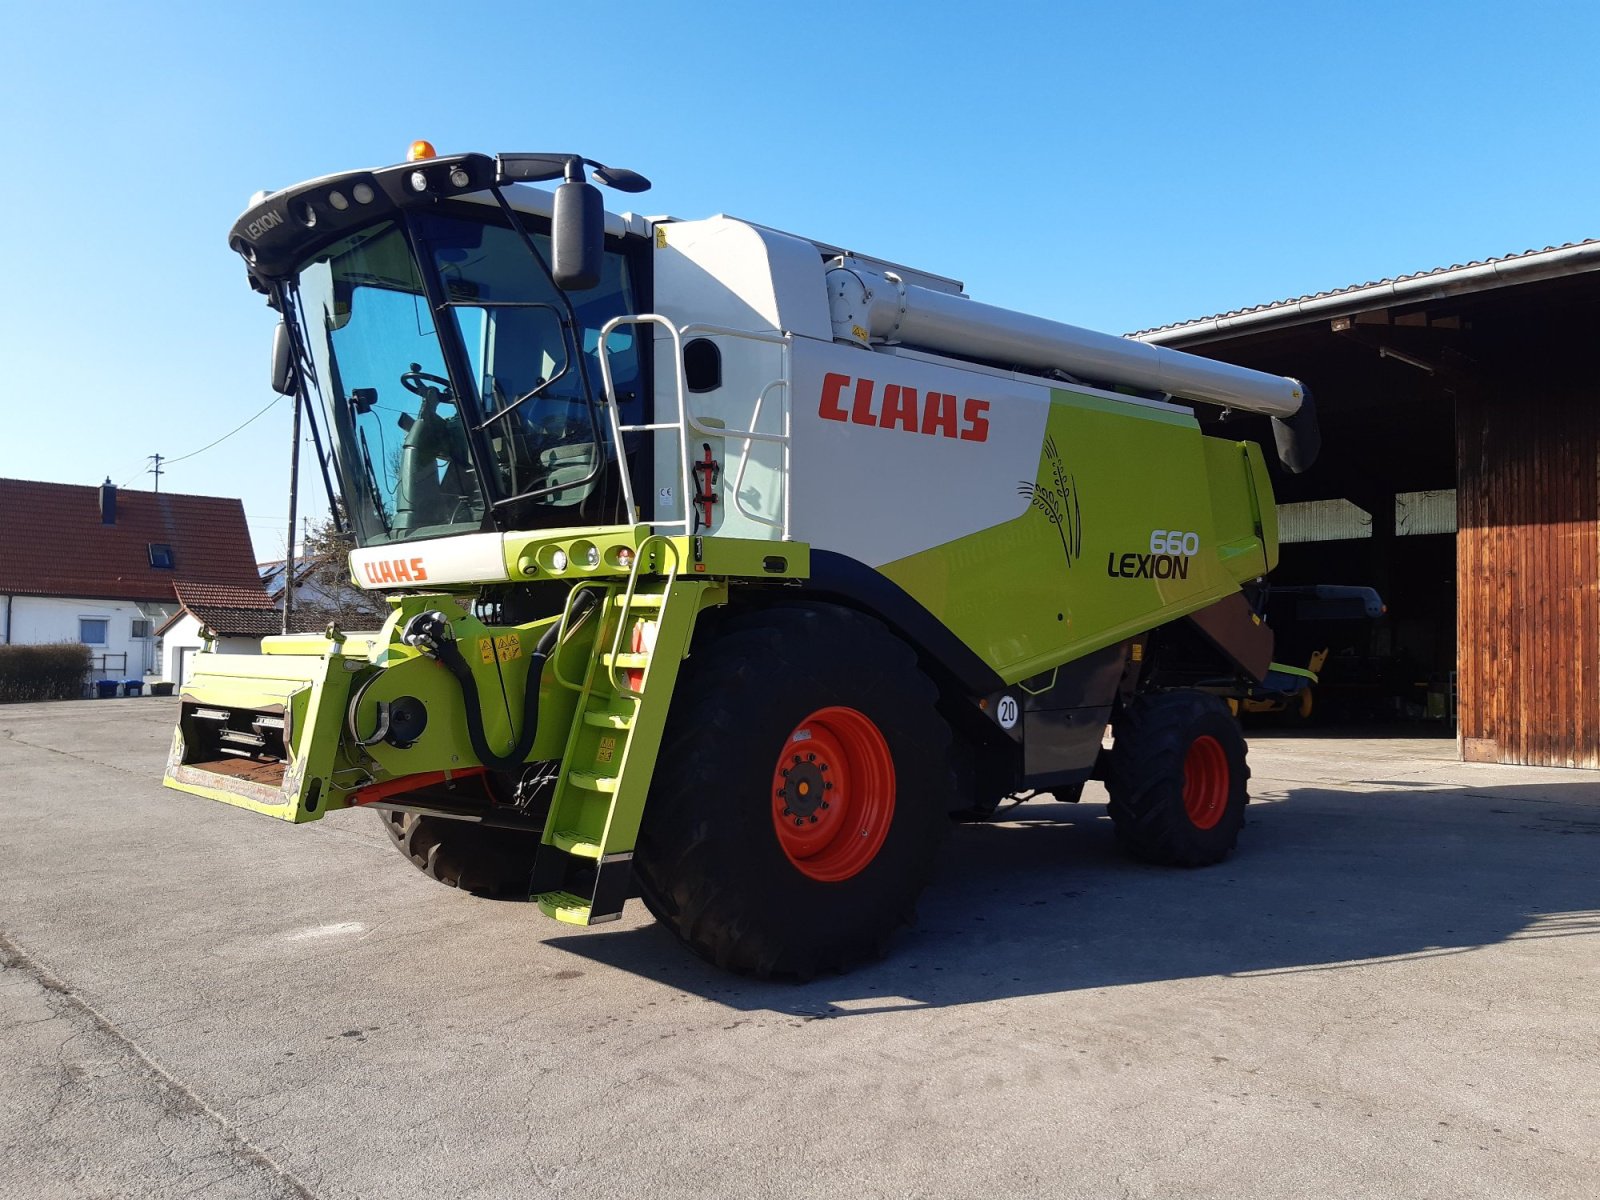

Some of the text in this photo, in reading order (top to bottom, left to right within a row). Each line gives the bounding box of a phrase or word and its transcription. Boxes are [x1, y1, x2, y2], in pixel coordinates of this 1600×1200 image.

[244, 209, 284, 240] LEXION
[818, 372, 990, 443] CLAAS
[1149, 529, 1199, 556] 660
[364, 557, 428, 584] CLAAS
[1107, 552, 1189, 580] LEXION
[1001, 701, 1015, 722] 20
